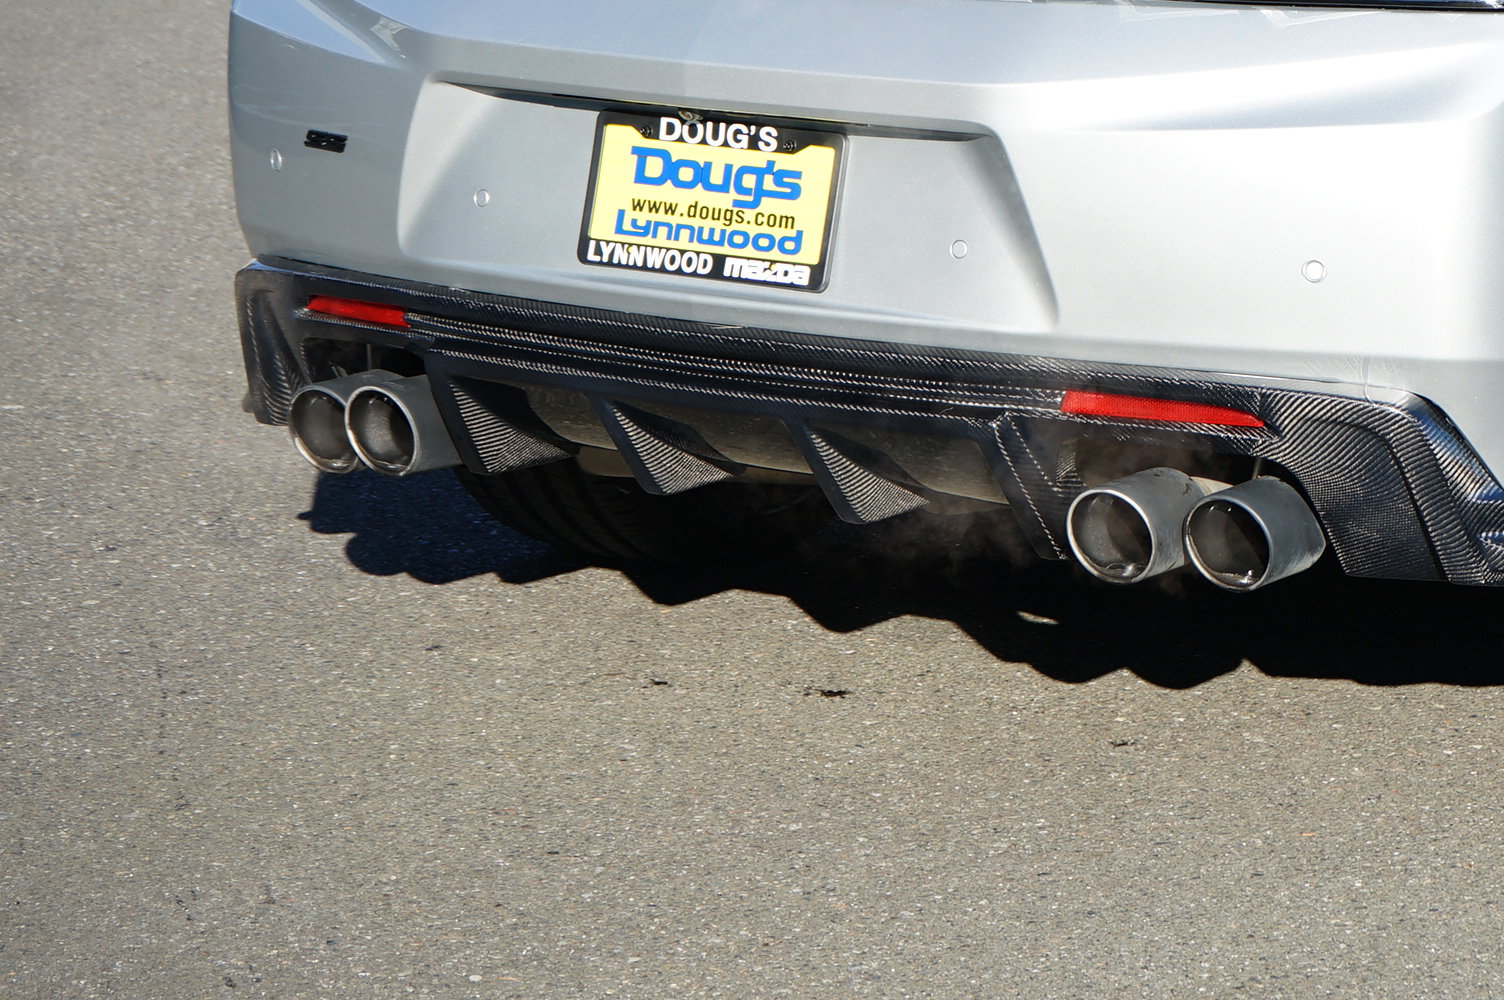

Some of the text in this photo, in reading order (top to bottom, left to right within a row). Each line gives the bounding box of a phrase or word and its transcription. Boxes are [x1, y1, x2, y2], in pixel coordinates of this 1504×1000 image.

[658, 116, 779, 152] DOUG'S
[631, 145, 803, 210] Doug's
[614, 208, 804, 256] Lynnwood
[631, 198, 795, 230] www.dougs.com
[586, 240, 714, 275] LYNNWOOD
